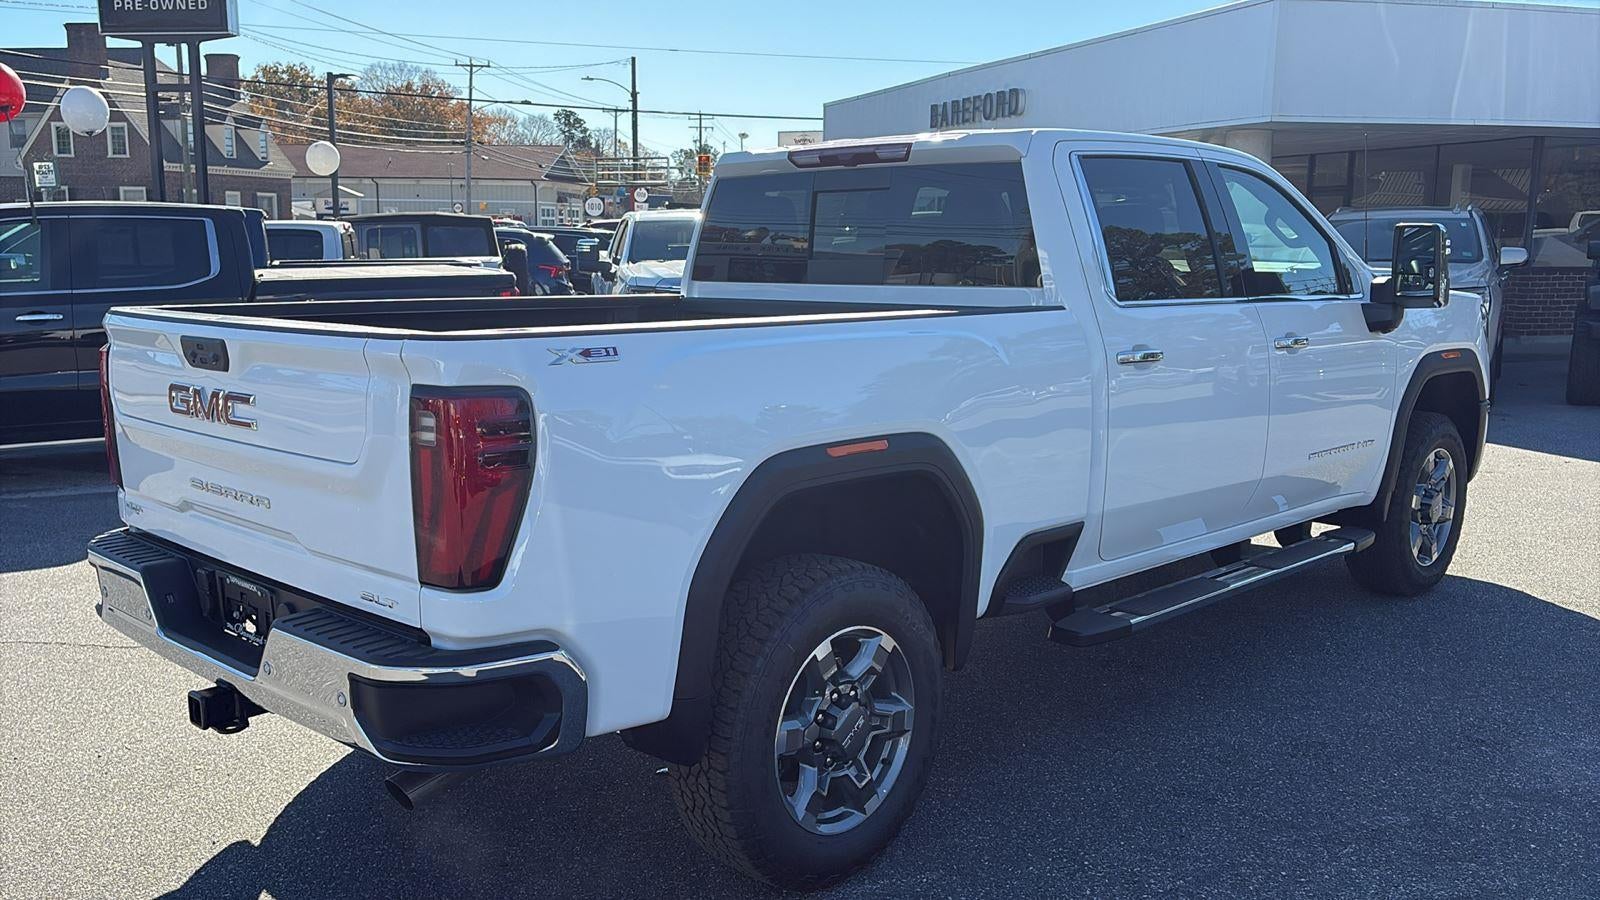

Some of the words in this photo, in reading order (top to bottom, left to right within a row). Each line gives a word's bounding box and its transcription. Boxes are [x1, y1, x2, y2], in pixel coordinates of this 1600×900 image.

[114, 0, 208, 10] PRE-OWNED
[930, 87, 1026, 129] BAREFORD
[587, 202, 602, 211] 1010
[168, 382, 258, 430] GMC
[190, 476, 271, 510] SIERRA
[360, 590, 400, 609] SLT
